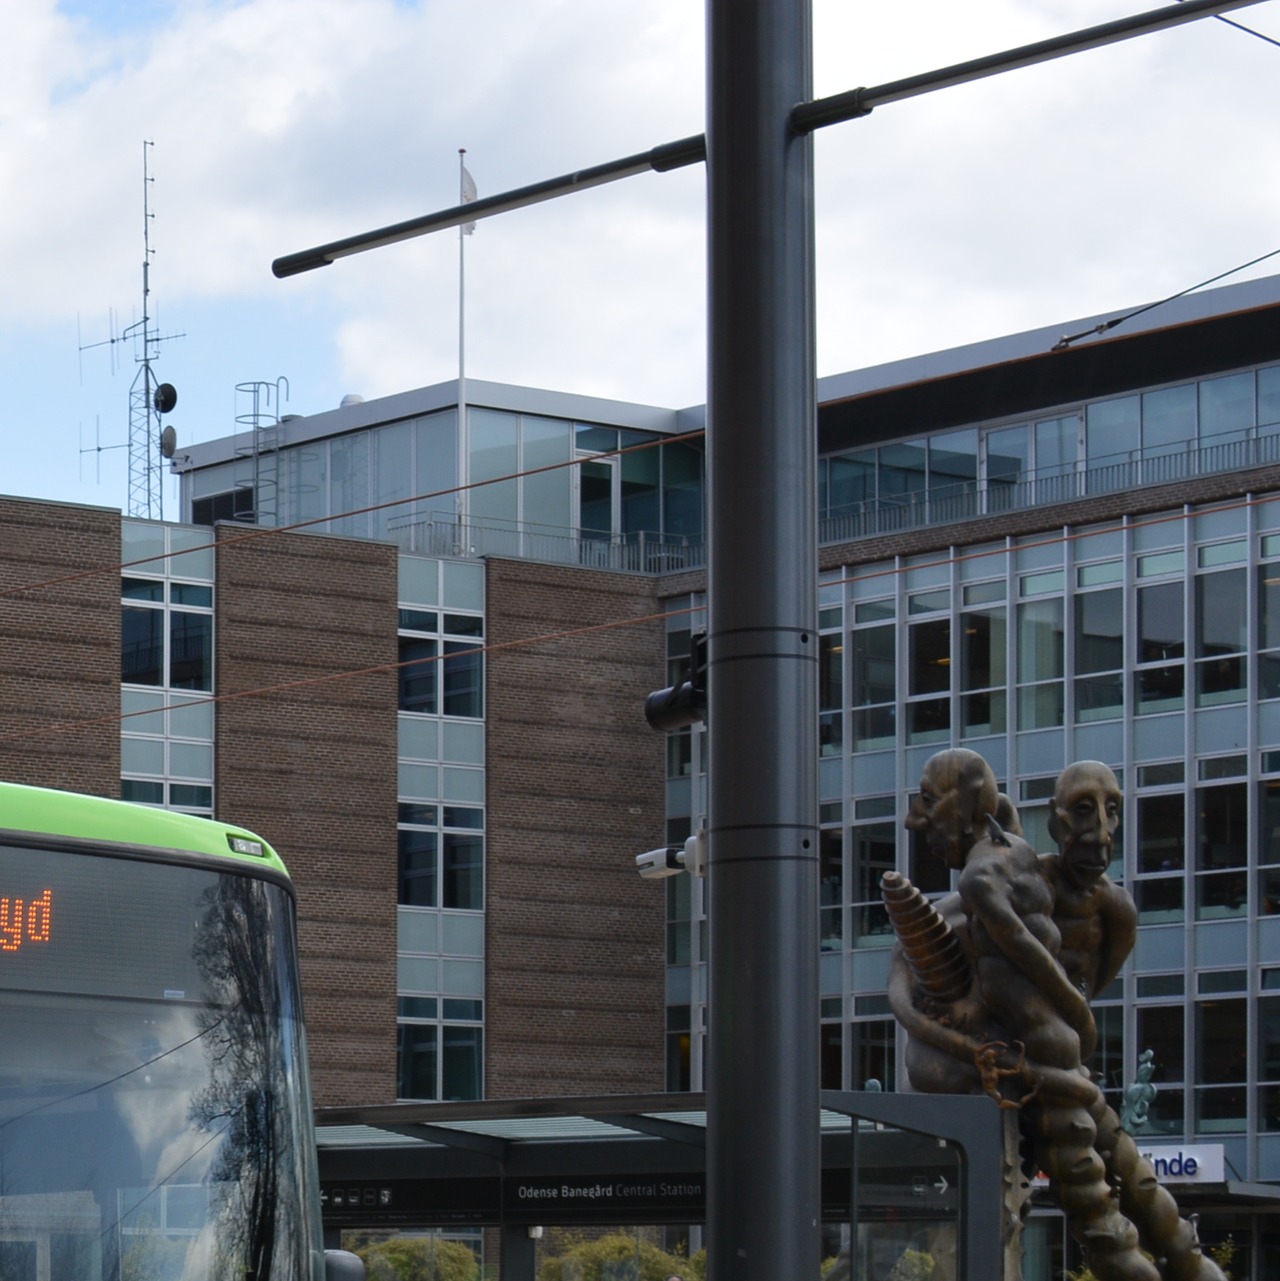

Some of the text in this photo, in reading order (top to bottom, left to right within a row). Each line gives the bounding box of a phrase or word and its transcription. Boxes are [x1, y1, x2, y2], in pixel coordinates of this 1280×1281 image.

[1144, 1152, 1198, 1176] nde
[518, 1182, 702, 1199] Odense Banegård Central Station
